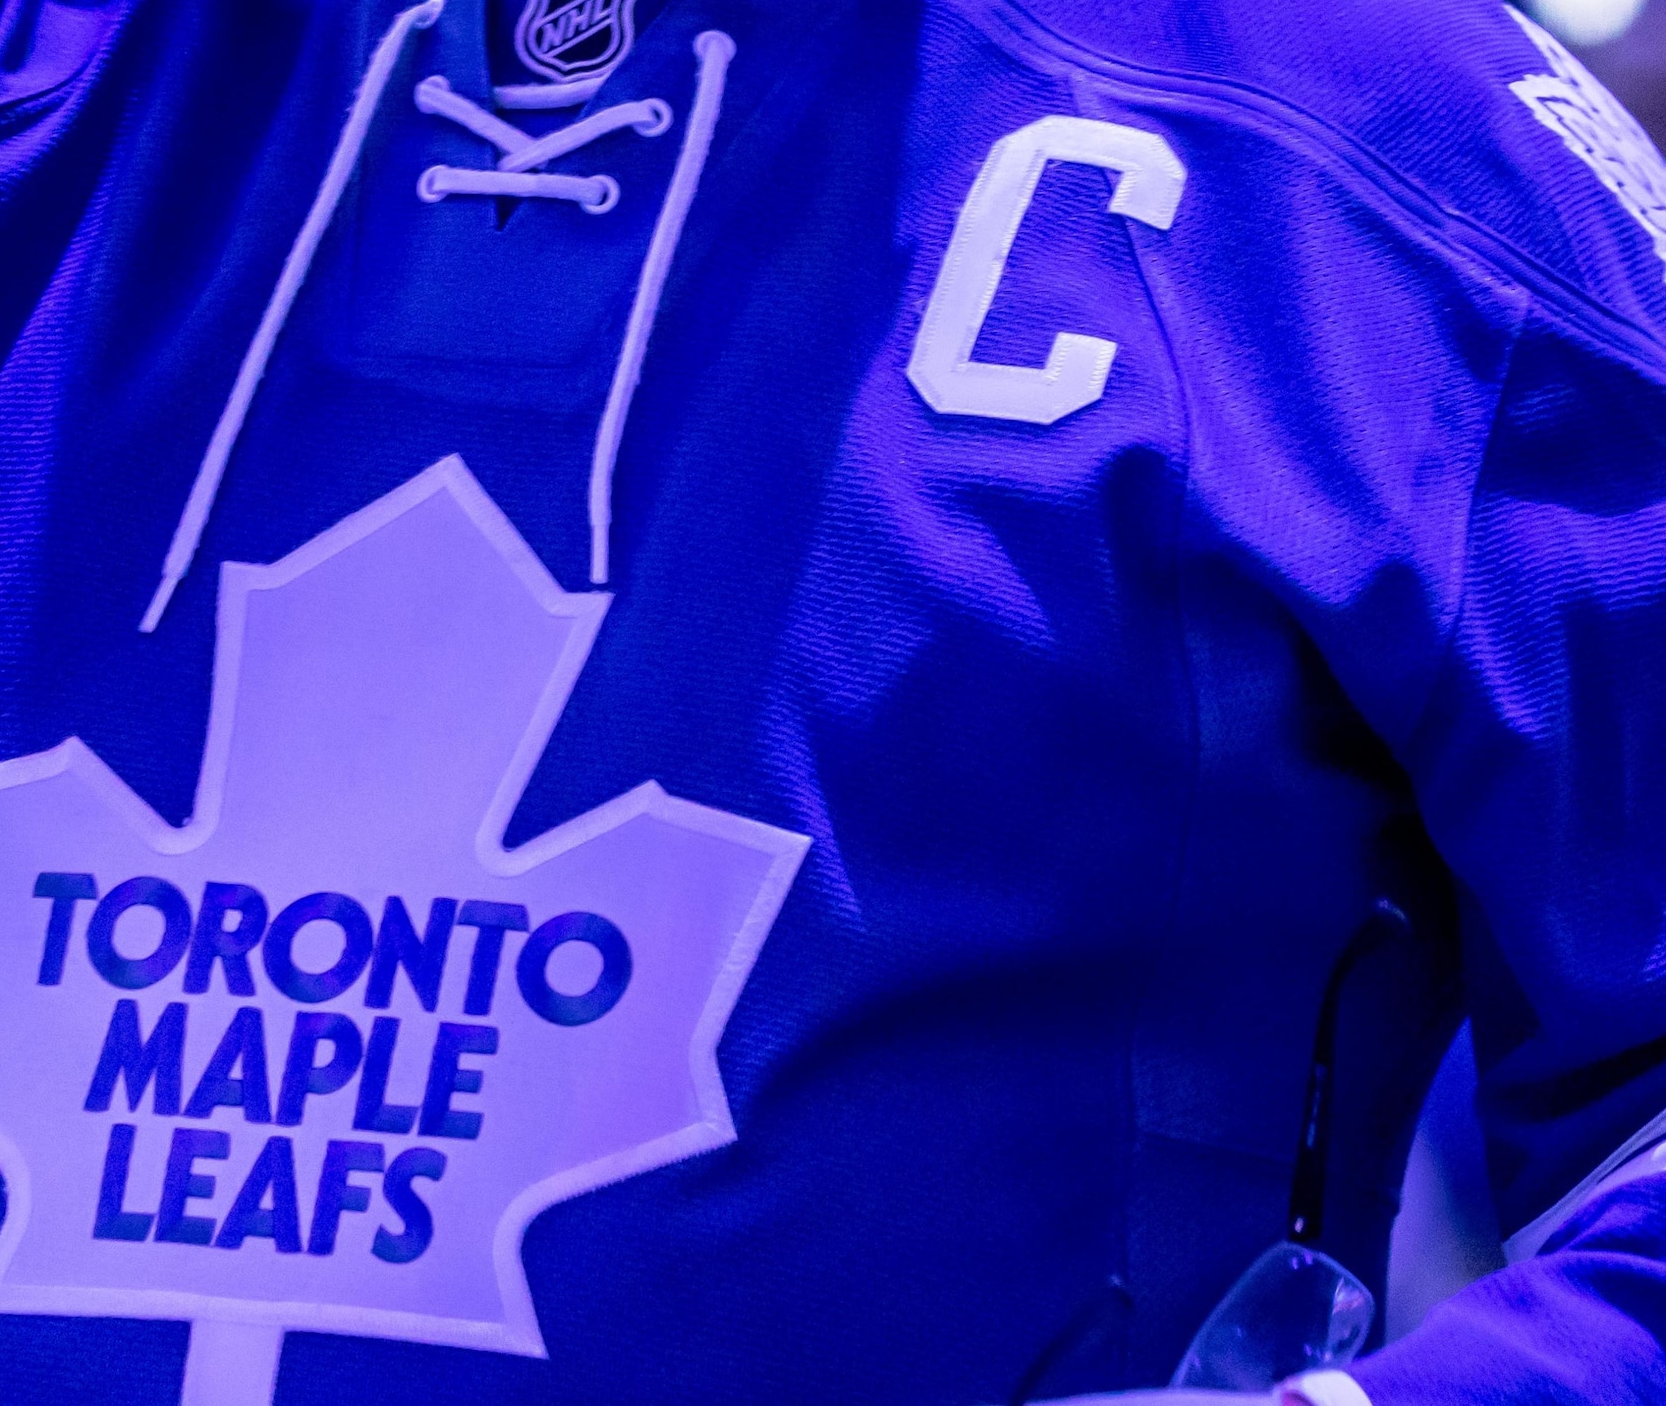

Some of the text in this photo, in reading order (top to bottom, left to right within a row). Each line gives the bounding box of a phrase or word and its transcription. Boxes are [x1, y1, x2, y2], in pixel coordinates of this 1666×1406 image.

[906, 114, 1188, 425] C
[31, 871, 633, 1027] TORONTO
[82, 998, 500, 1141] MAPLE
[91, 1122, 448, 1265] LEAFS
